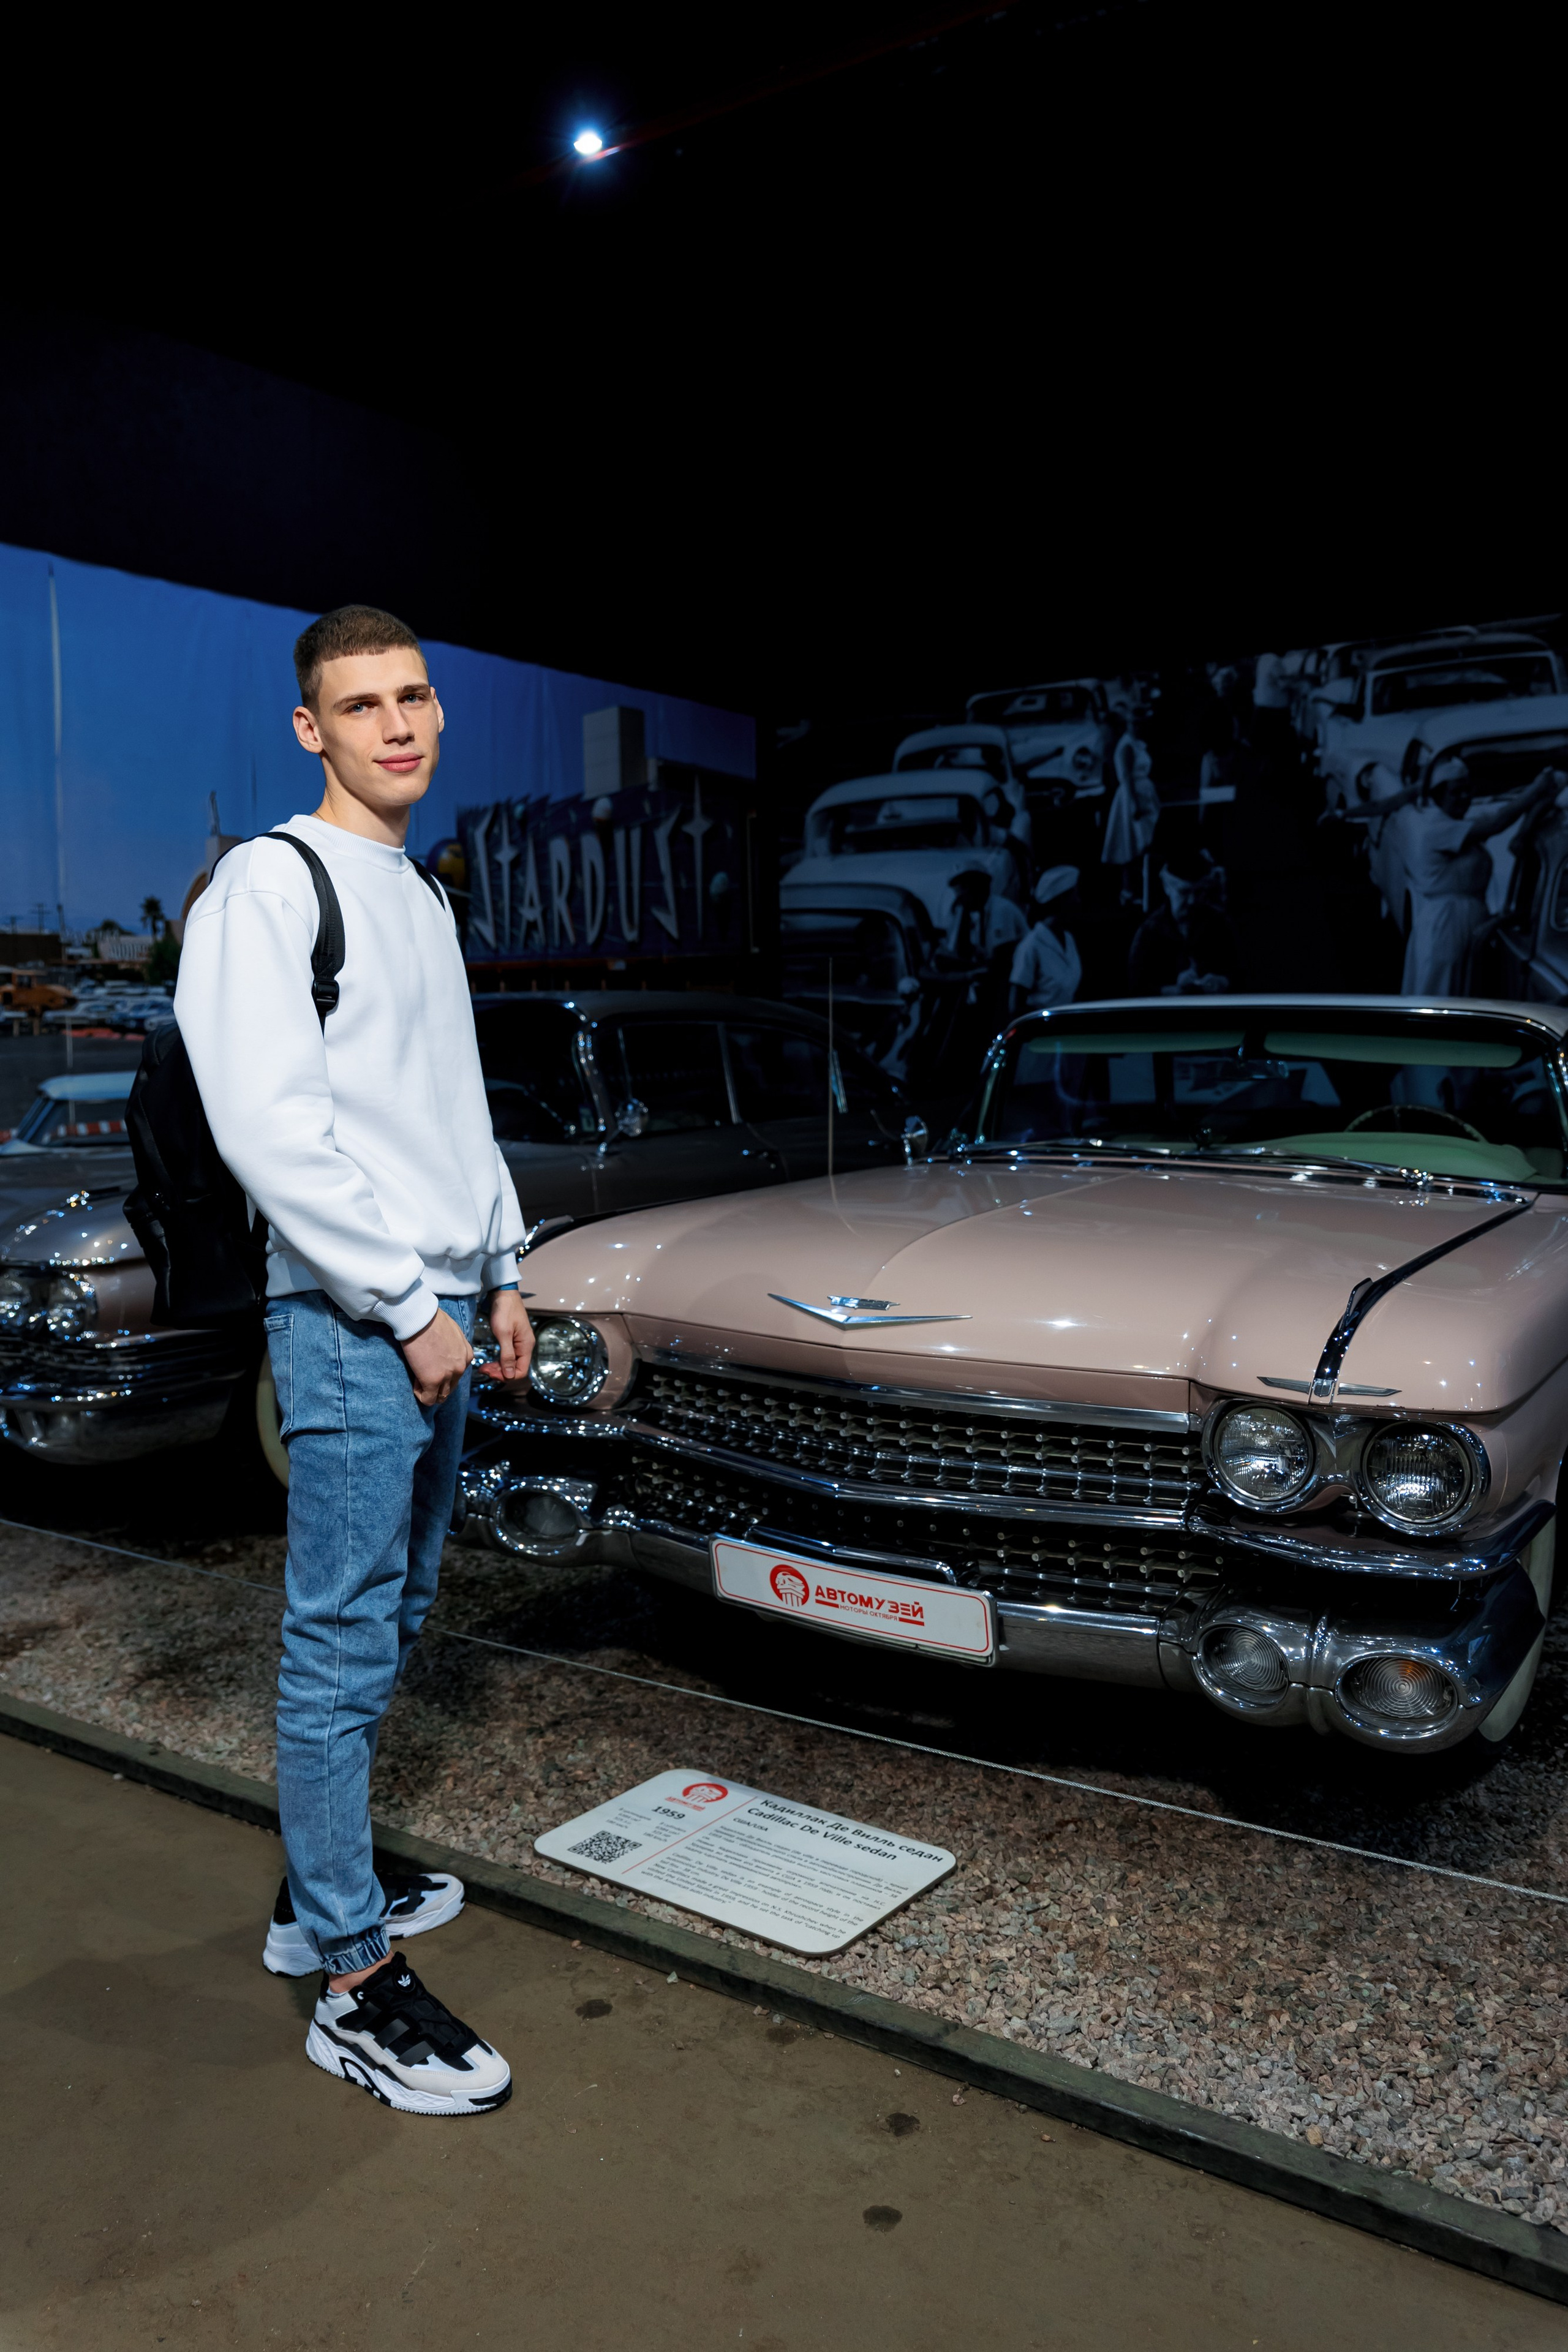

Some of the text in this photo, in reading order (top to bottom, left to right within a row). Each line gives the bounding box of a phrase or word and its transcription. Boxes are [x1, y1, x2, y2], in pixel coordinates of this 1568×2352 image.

[472, 774, 713, 949] STARDUST
[815, 1585, 924, 1619] АВТОМУЗЕЙ
[840, 1604, 898, 1621] МОТОРЫ ОКТЯБРЯ
[652, 1806, 685, 1820] 1959
[747, 1807, 897, 1860] Cadillac De Ville sedan
[760, 1800, 943, 1863] Кадиллак Де Вилль седан
